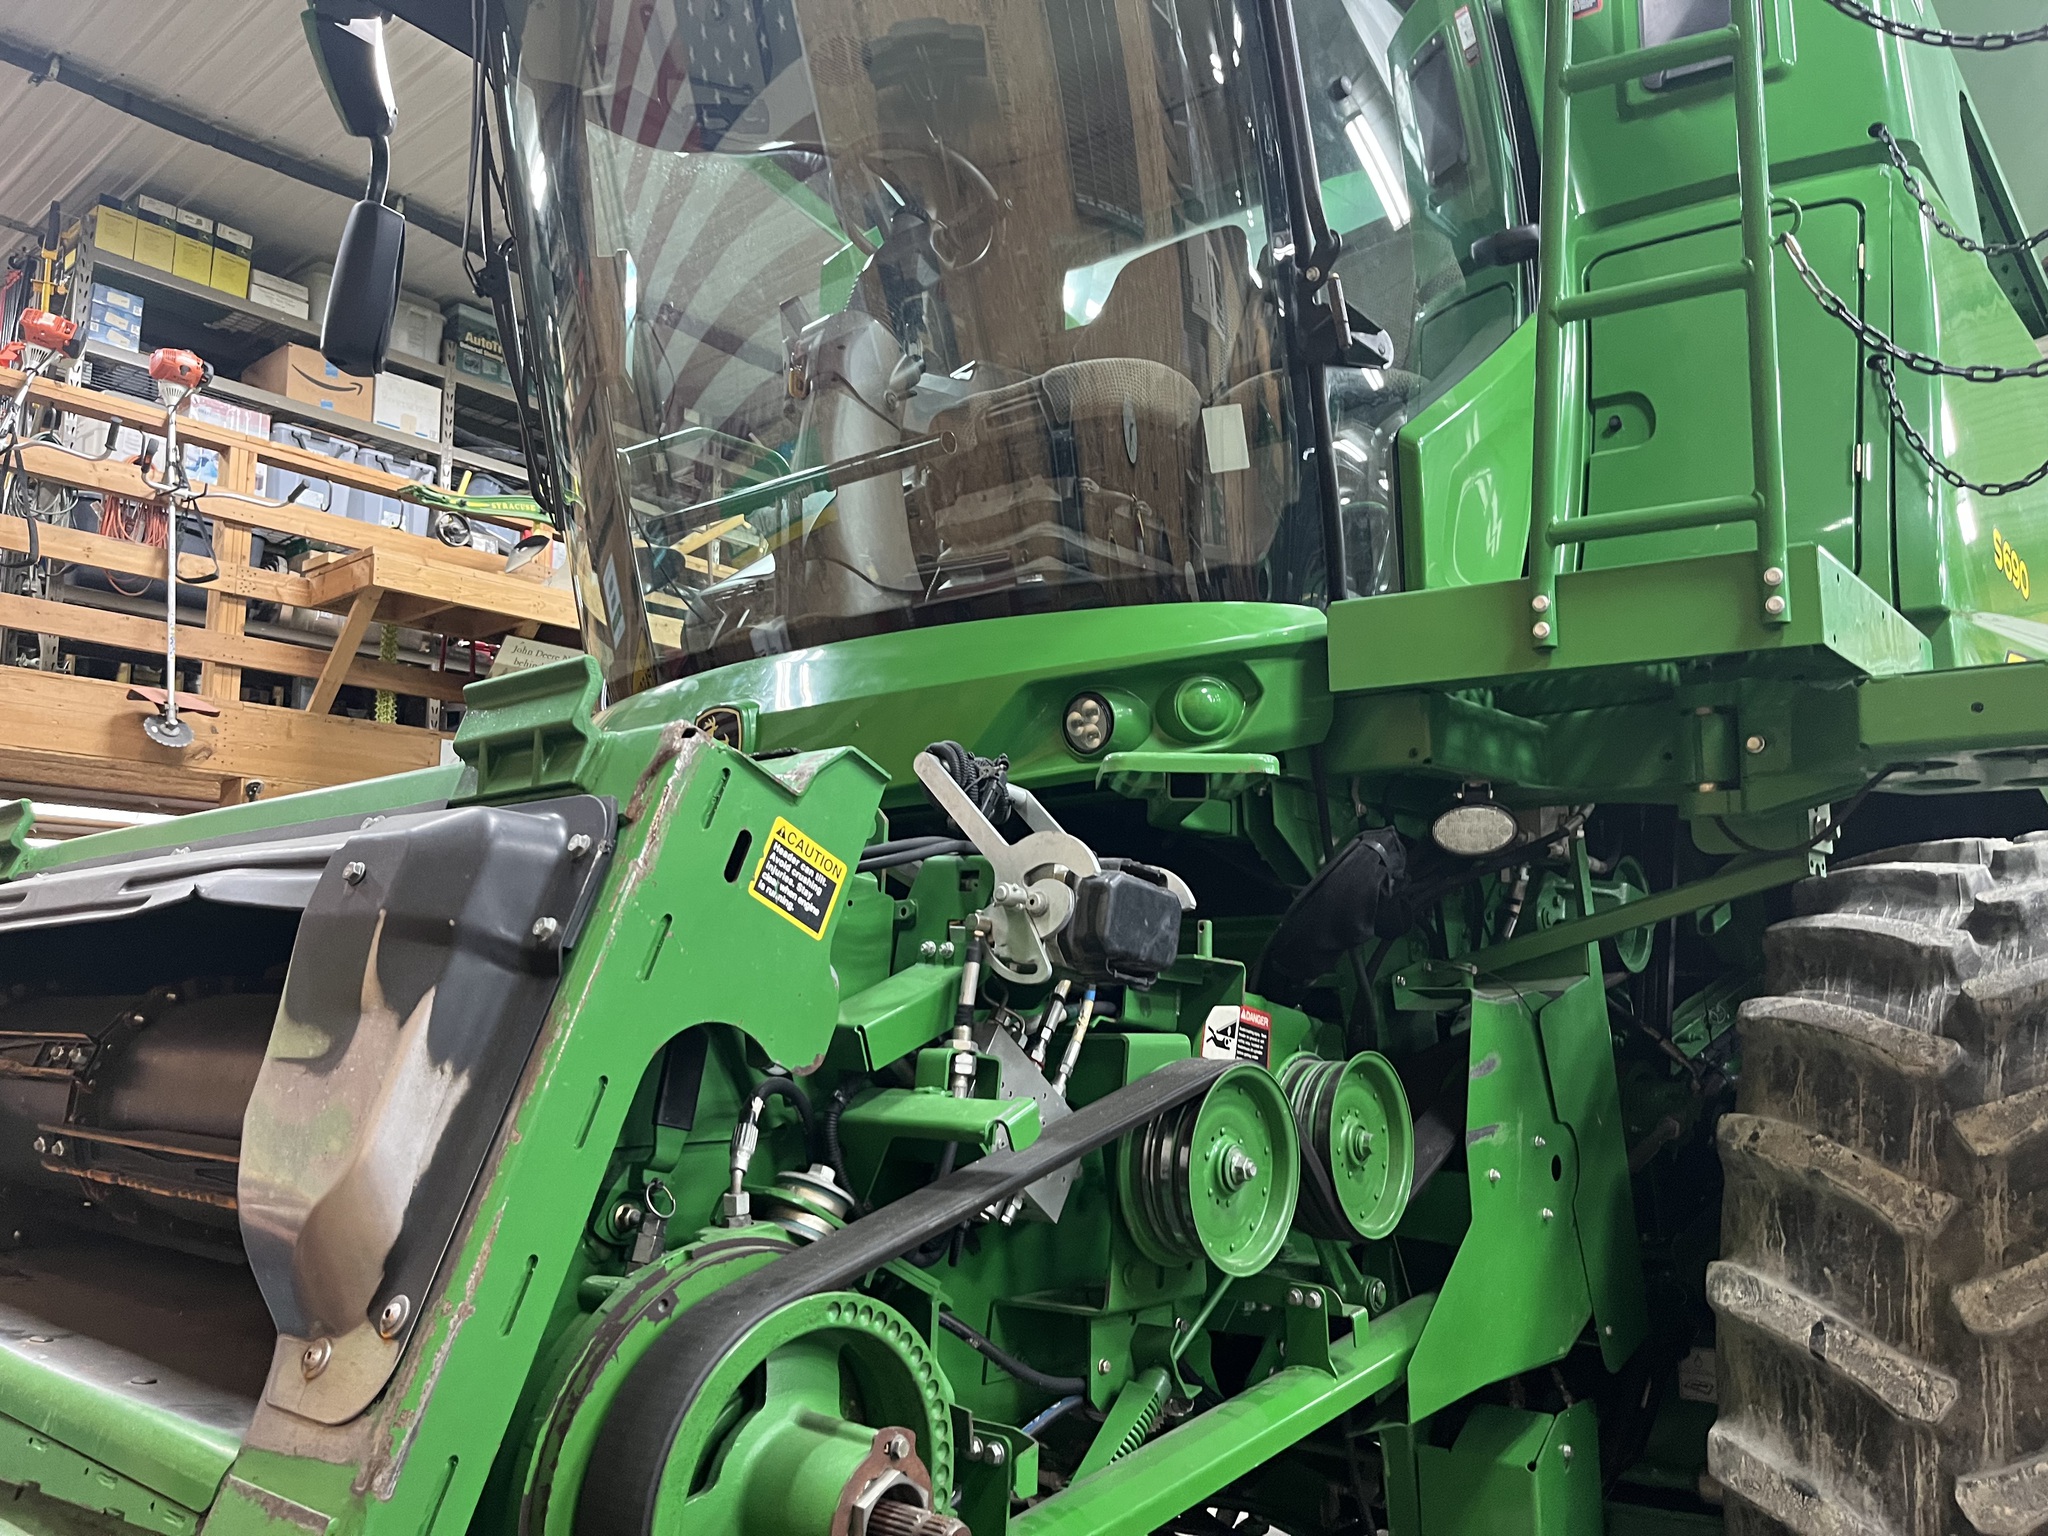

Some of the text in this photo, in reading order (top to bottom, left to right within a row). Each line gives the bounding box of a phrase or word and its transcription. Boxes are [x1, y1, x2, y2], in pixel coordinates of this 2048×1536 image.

[465, 331, 502, 353] AutoTr
[491, 502, 536, 512] SYRACUSE
[1992, 527, 2030, 601] S690
[511, 645, 533, 656] John
[535, 649, 560, 660] Deere
[773, 842, 828, 887] Header can tilt.
[787, 832, 842, 879] CAUTION
[769, 852, 823, 896] Avoid crushing
[757, 880, 766, 891] is
[796, 883, 814, 900] Stay
[779, 884, 797, 901] when
[797, 896, 820, 916] engine
[1245, 1010, 1269, 1027] DANGER
